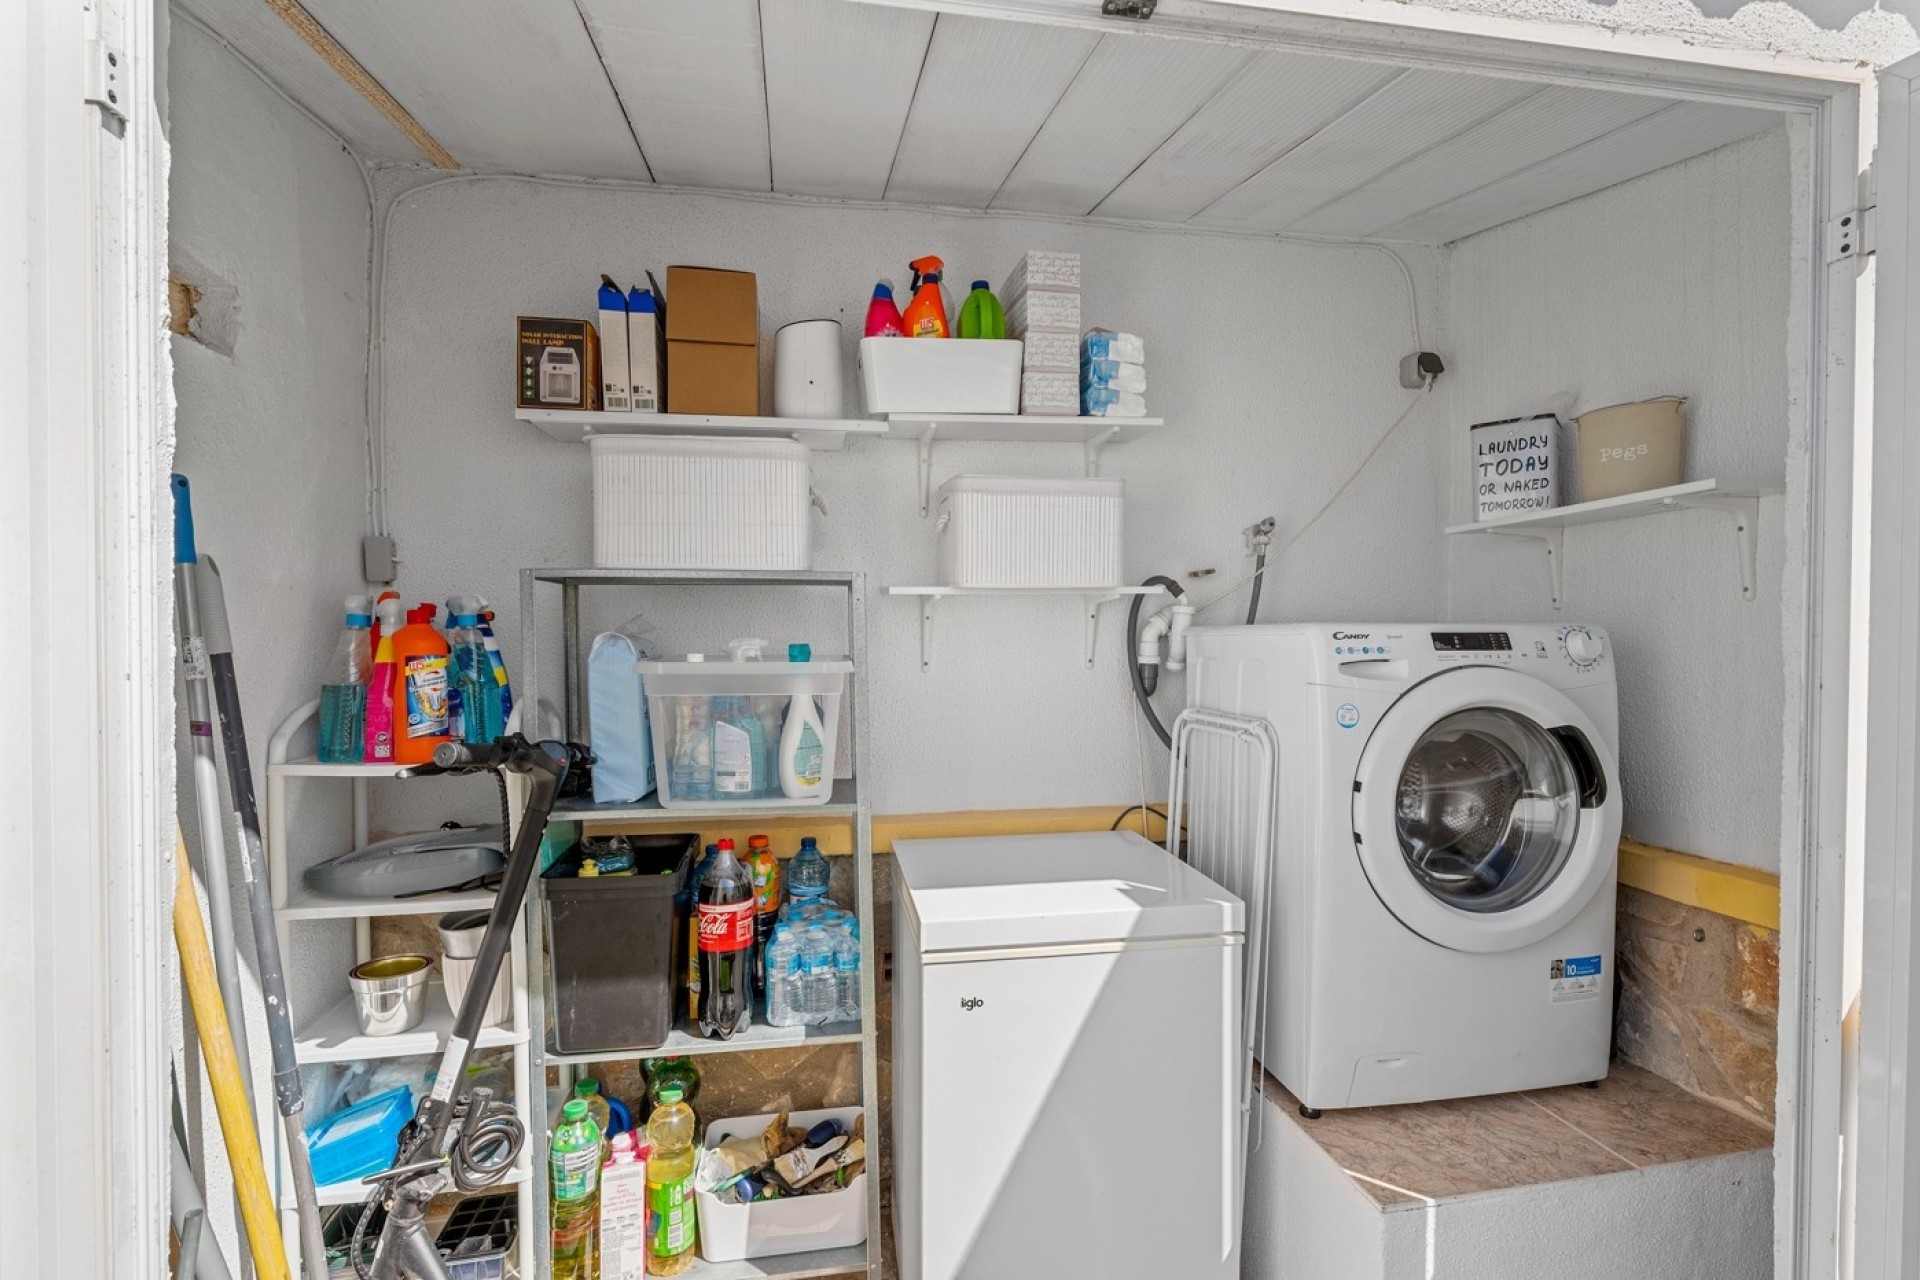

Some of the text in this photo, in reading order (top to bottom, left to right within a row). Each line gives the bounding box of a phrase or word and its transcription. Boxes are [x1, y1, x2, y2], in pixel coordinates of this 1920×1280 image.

[521, 331, 584, 341] SOLAR INTERACTION
[1479, 435, 1548, 456] LAUNDRY
[1598, 444, 1649, 463] Pegs
[1479, 456, 1549, 477] TODAY
[1480, 478, 1549, 495] OR NAKED
[1480, 496, 1551, 512] TOMORROW!
[1567, 965, 1577, 976] 10
[961, 996, 985, 1012] iiglo
